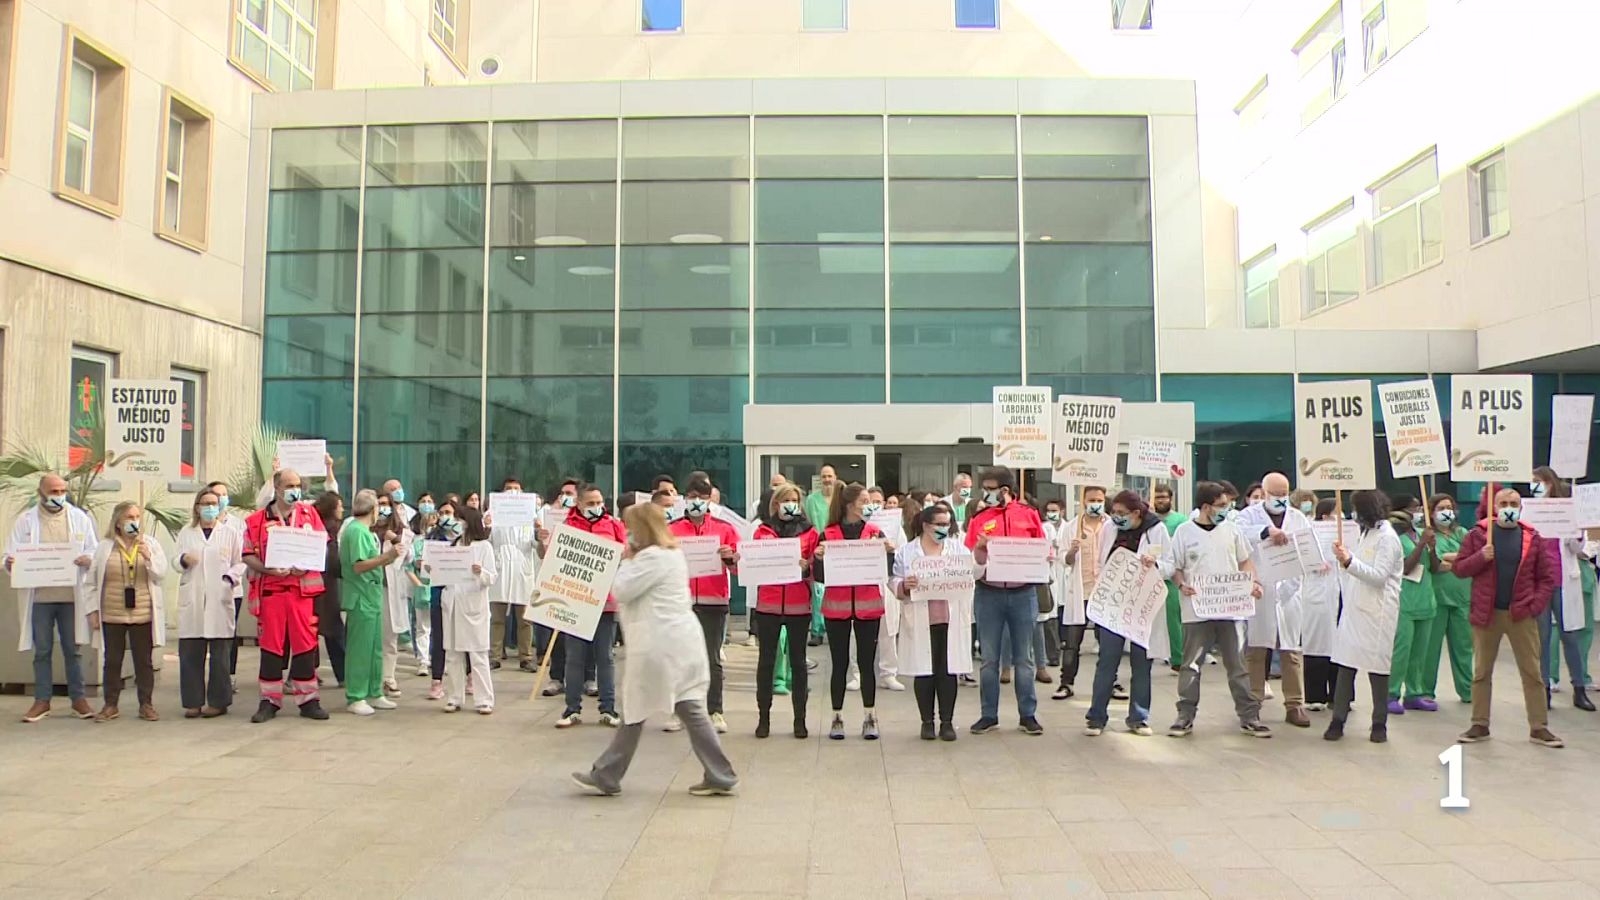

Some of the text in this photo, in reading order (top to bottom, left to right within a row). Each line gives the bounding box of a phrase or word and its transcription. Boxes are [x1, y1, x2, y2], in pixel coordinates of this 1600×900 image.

[112, 387, 177, 405] ESTATUTO
[998, 393, 1046, 403] CONDICIONES
[1384, 388, 1430, 402] CONDICIONES
[1462, 389, 1522, 410] A PLUS
[118, 404, 170, 424] MÉDICO
[1001, 404, 1042, 414] LABORALES
[1062, 402, 1116, 419] ESTATUTO
[1305, 396, 1363, 418] A PLUS
[1390, 401, 1430, 414] LABORALES
[1008, 415, 1036, 425] JUSTAS
[1066, 417, 1109, 436] MÉDICO
[1400, 414, 1426, 426] JUSTAS
[1478, 414, 1506, 435] A1+
[122, 427, 165, 443] JUSTO
[1322, 423, 1348, 443] A1+
[1068, 438, 1104, 453] JUSTO
[557, 533, 614, 561] CONDICIONES
[556, 547, 606, 573] LABORALES
[560, 563, 594, 583] JUSTAS
